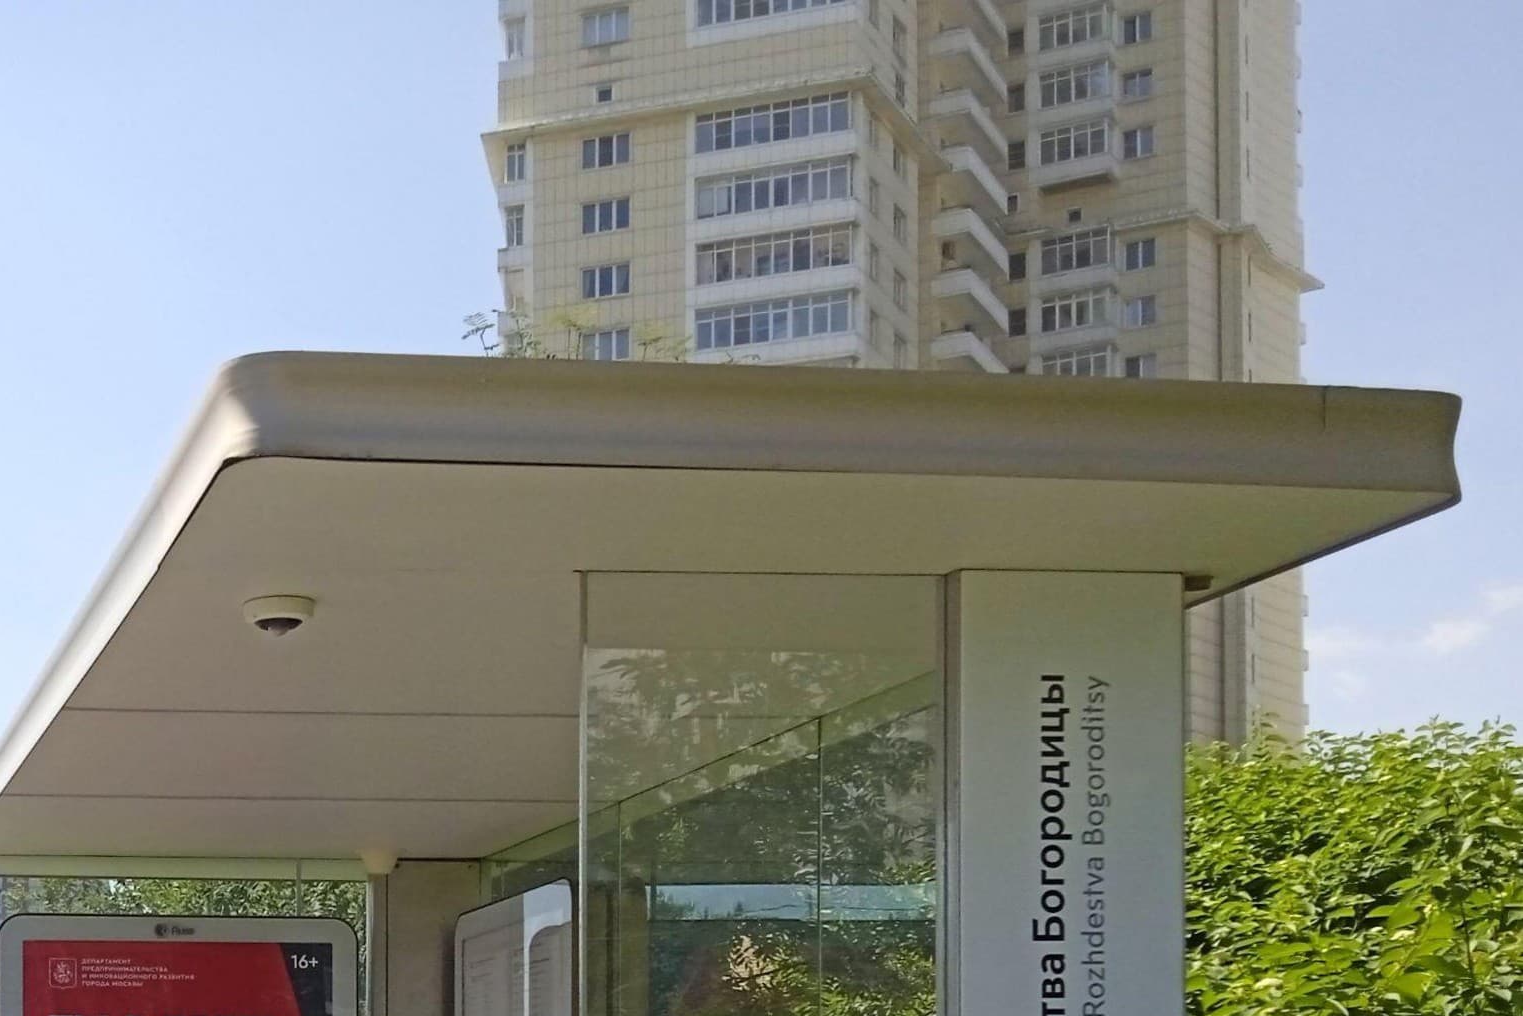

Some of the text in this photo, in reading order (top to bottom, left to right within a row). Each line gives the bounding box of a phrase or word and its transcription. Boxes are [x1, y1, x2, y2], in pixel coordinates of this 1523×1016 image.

[1032, 675, 1073, 943] Богородицы
[1080, 675, 1111, 846] Bogoroditsy
[290, 954, 319, 969] 16+
